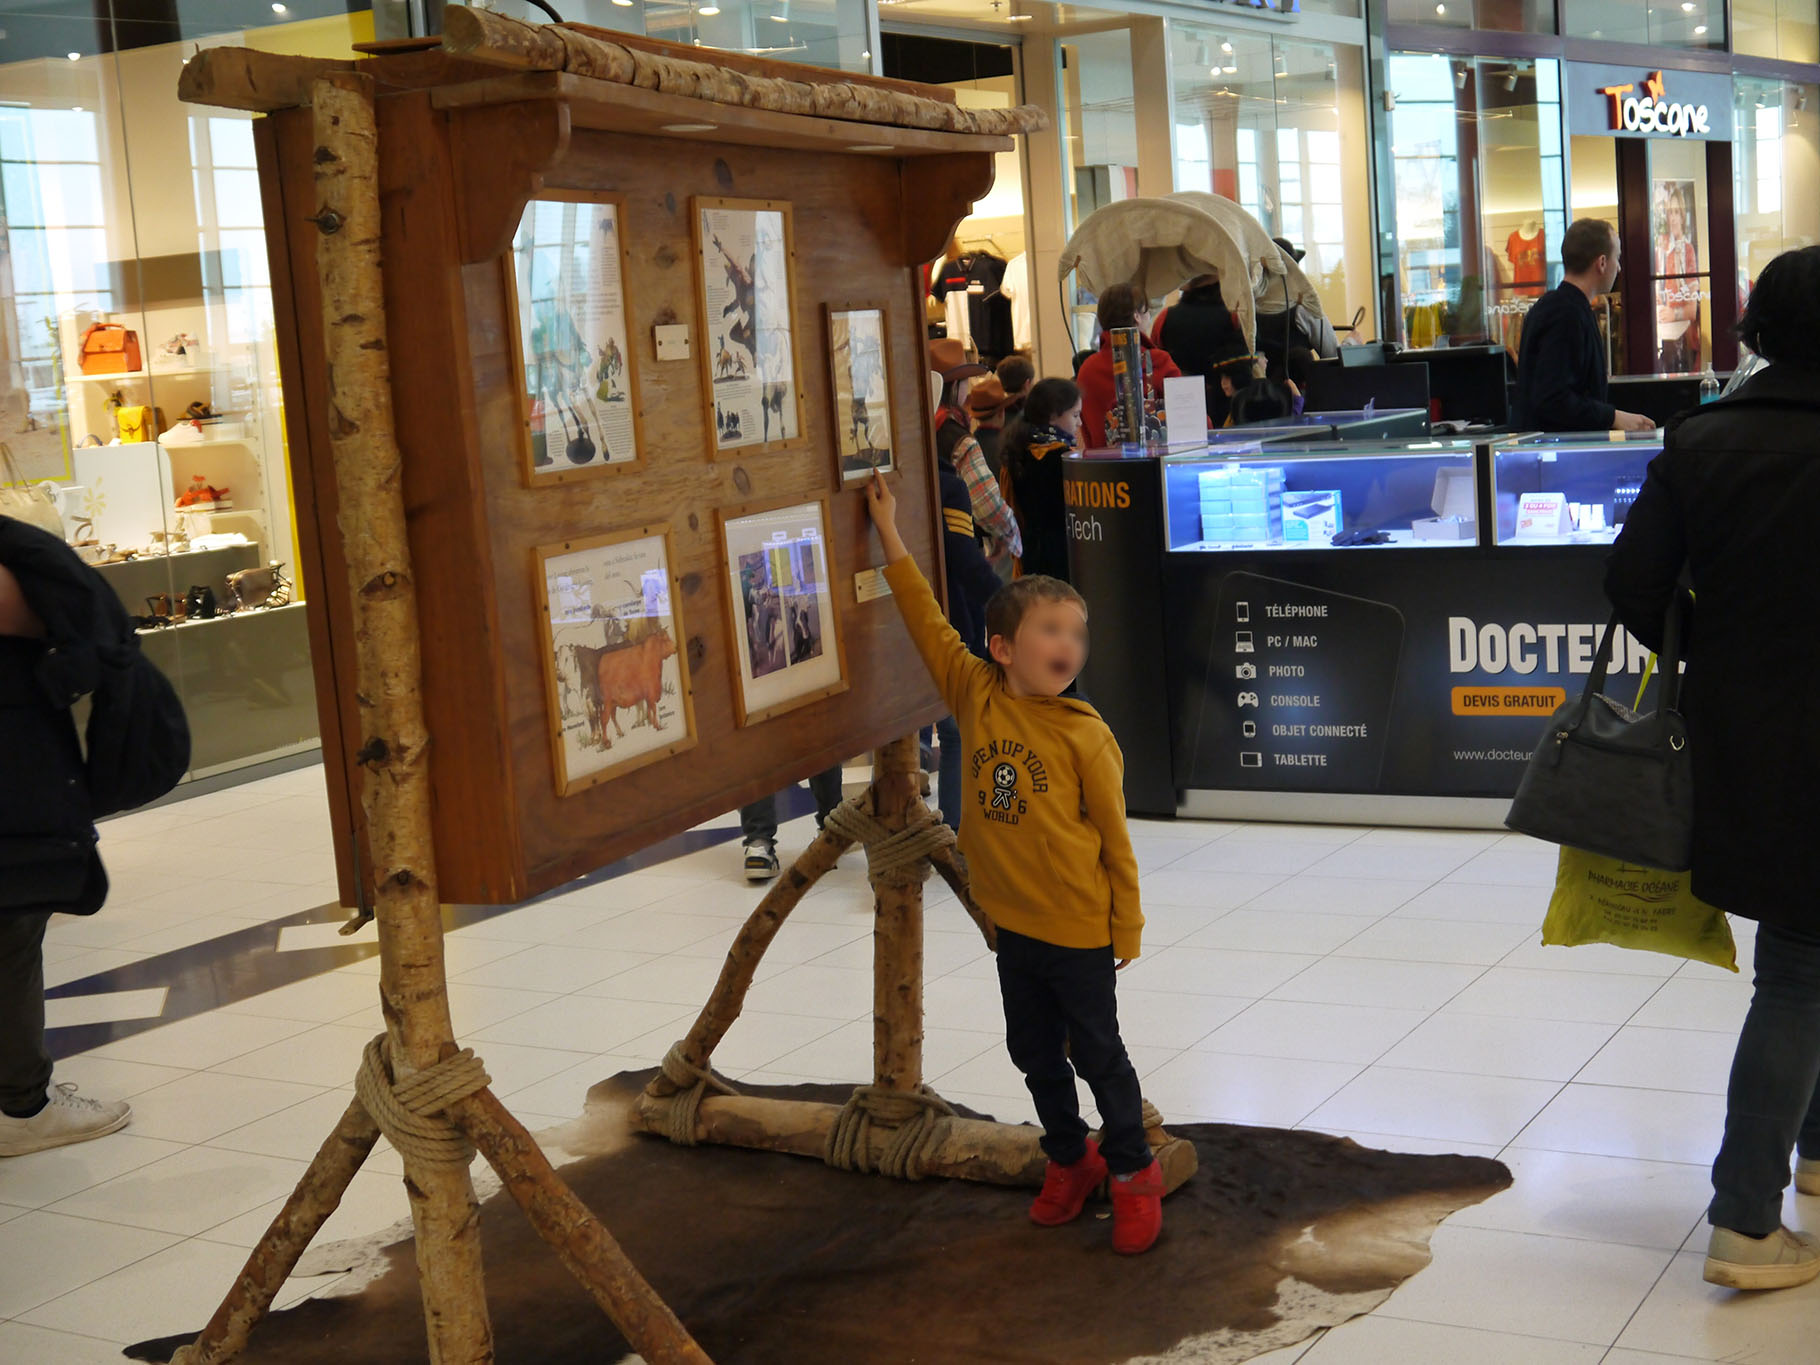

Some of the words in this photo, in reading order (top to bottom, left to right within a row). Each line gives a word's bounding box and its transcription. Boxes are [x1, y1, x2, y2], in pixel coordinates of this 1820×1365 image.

[1603, 83, 1711, 137] Toscane
[1659, 288, 1711, 306] Toscan
[1265, 604, 1328, 617] TÉLÉPHONE
[1267, 636, 1282, 647] PC
[1285, 636, 1289, 647] /
[1293, 636, 1318, 647] MAC
[1269, 665, 1305, 677] PHOTO
[1271, 695, 1321, 707] CONSOLE
[1463, 695, 1500, 707] DEVIS
[1503, 694, 1557, 708] GRATUIT
[1273, 724, 1306, 736] OBJET
[1309, 723, 1368, 737] CONNECTÉ
[1001, 739, 1024, 758] UP
[1022, 750, 1049, 794] YOUR
[1274, 753, 1327, 766] TABLETTE
[978, 790, 987, 806] 9
[1018, 800, 1028, 814] 6
[983, 808, 1020, 825] WORLD
